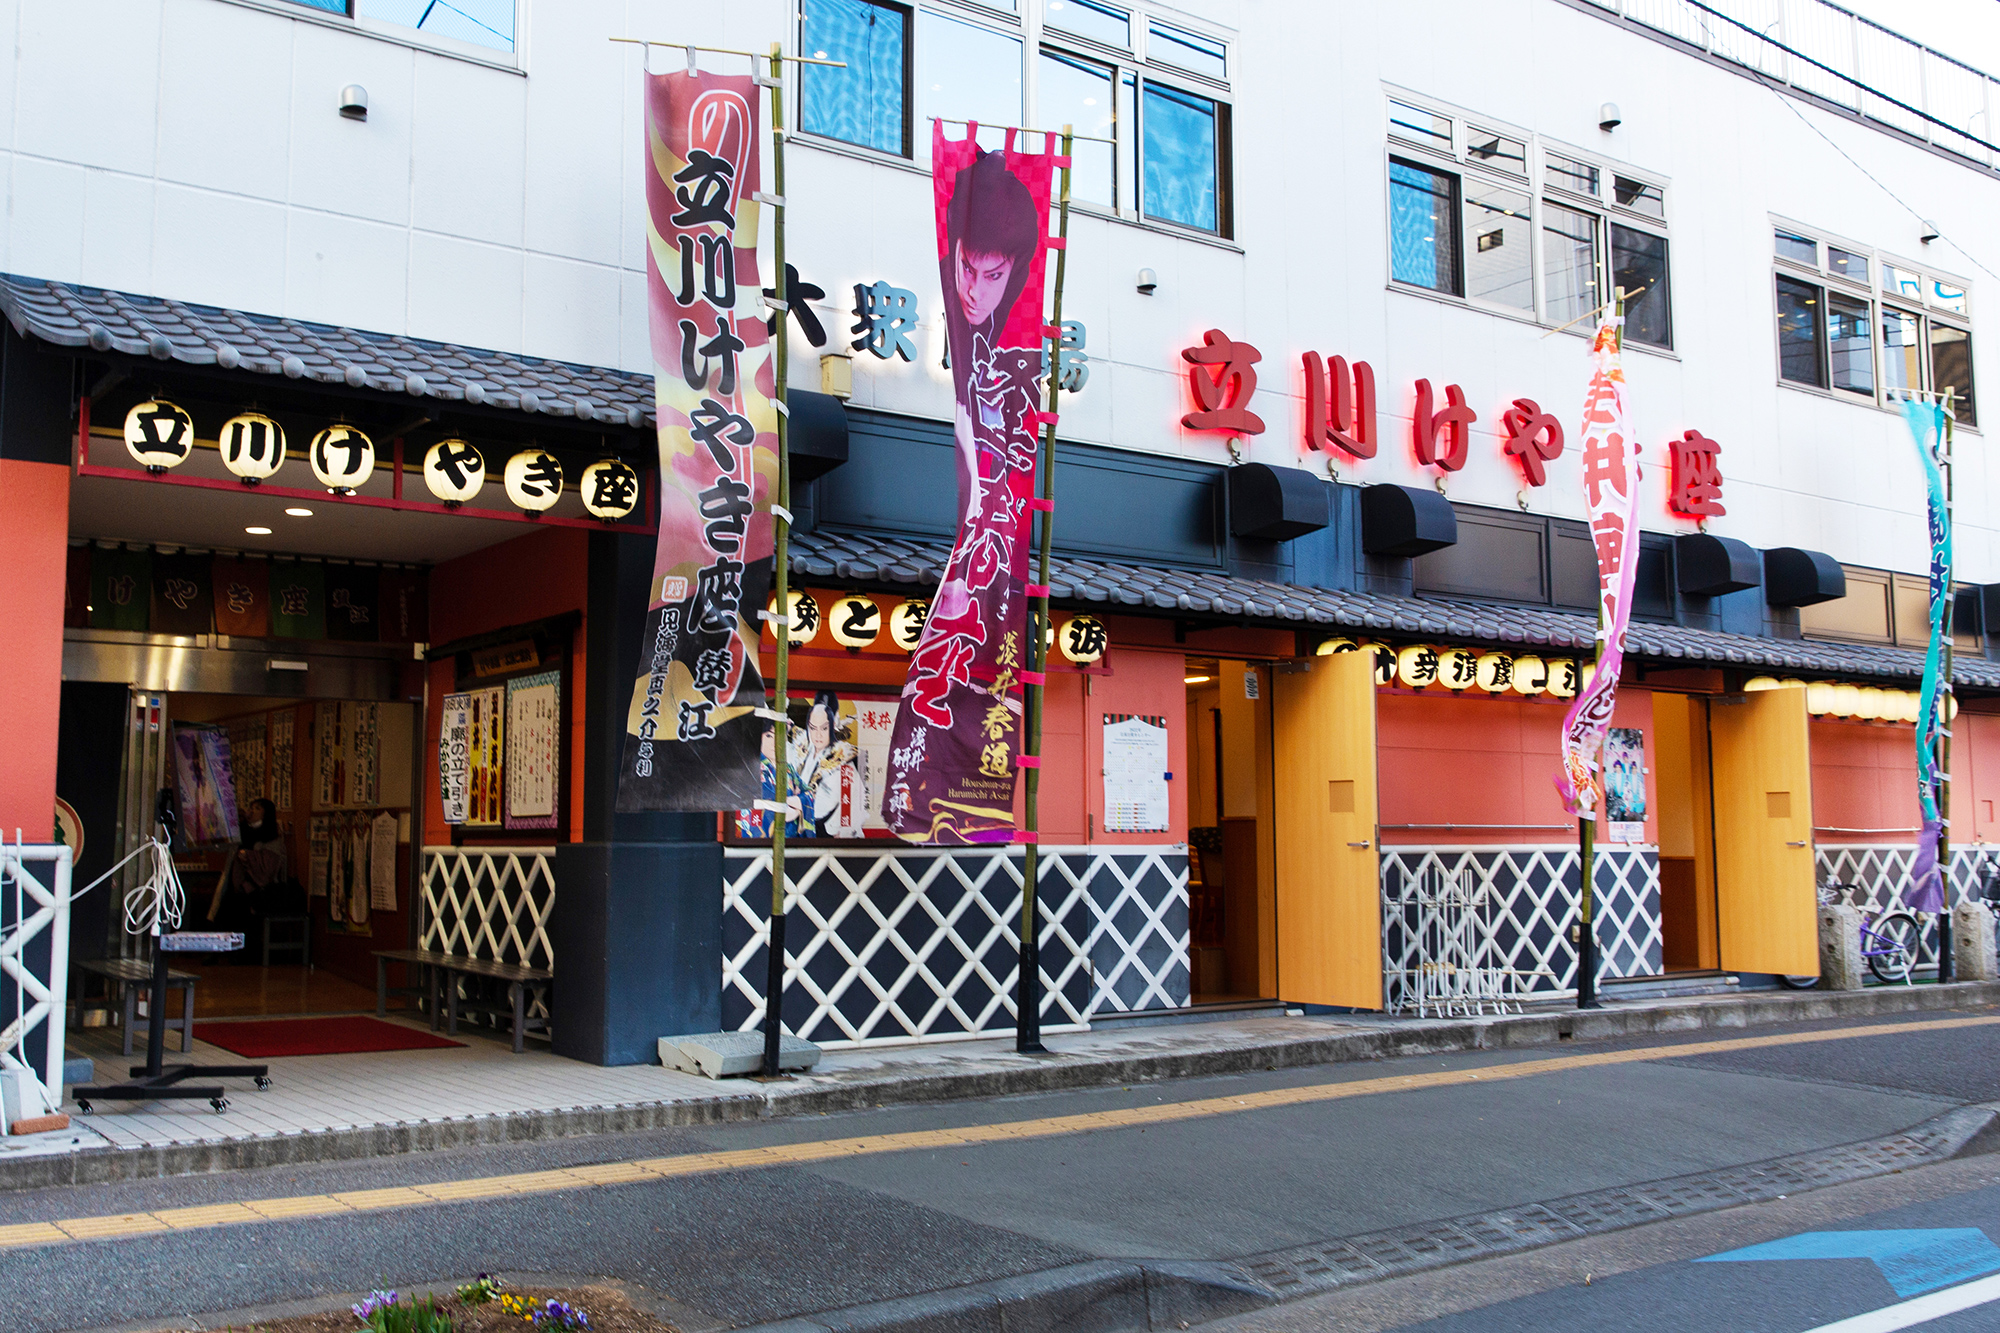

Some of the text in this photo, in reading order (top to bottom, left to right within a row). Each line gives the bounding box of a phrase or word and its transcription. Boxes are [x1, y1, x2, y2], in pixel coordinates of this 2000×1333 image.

[763, 263, 1088, 393] 大衆場
[133, 408, 638, 510] 立川けやき座
[1181, 328, 1727, 517] 立川けや座
[979, 630, 1020, 778] 浅井春道
[948, 788, 1010, 801] Harumichi Asai
